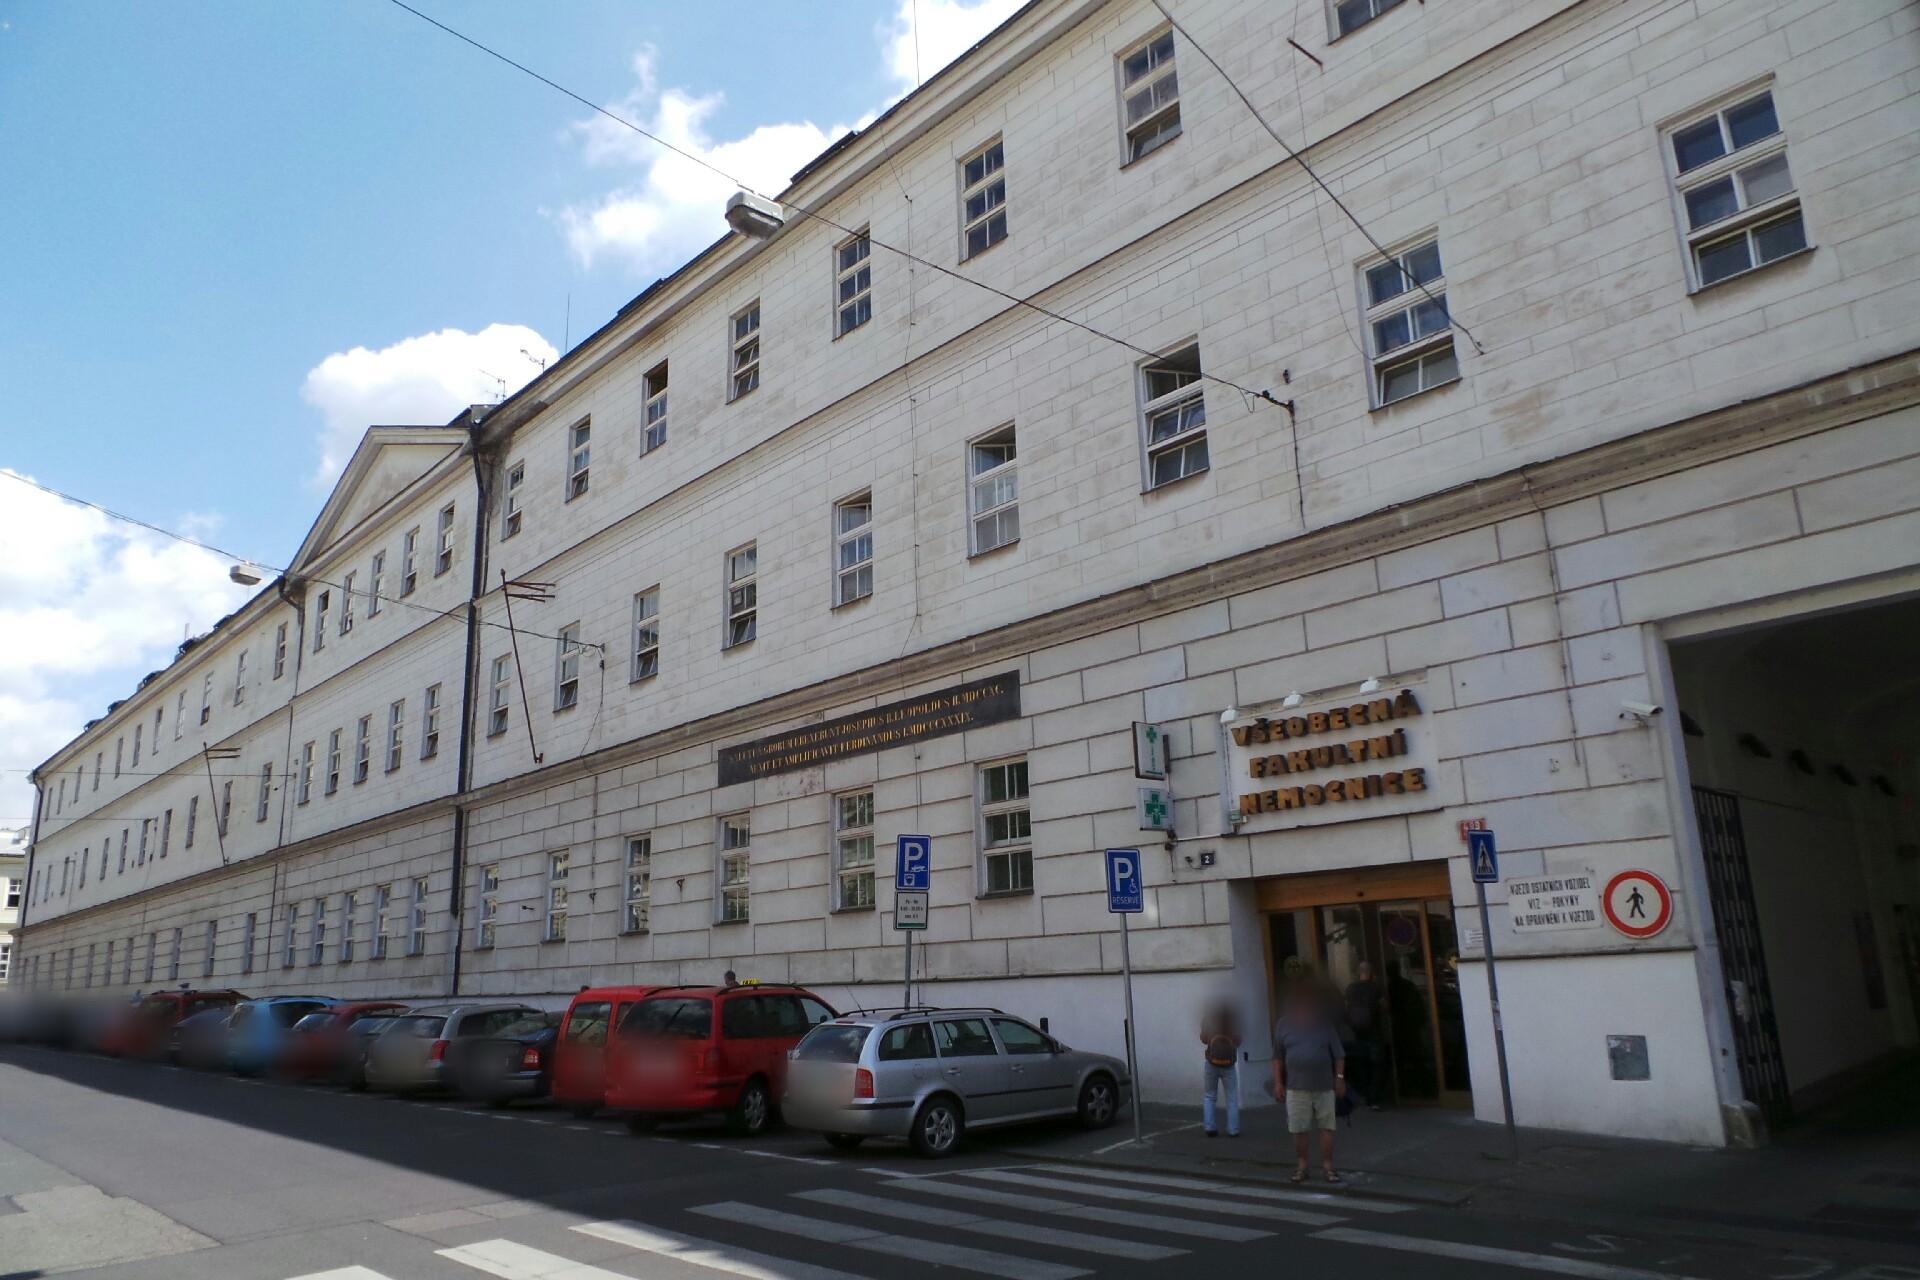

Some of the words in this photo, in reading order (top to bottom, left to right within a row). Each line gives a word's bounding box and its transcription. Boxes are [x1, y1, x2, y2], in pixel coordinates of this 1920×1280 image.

[842, 716, 885, 734] JOSEPHUS
[895, 699, 950, 720] LEOPOLDUS
[962, 685, 1004, 703] MDCCXC.
[1231, 689, 1423, 746] VŠEOBECNÁ
[772, 758, 782, 769] ET
[840, 730, 901, 752] FERDINANDUS
[1249, 728, 1408, 779] FAKULTNÍ
[1239, 767, 1427, 816] NEMOCNICE
[905, 842, 923, 872] P
[1113, 857, 1132, 892] P
[1204, 855, 1210, 864] 2
[1510, 883, 1530, 895] VJEZD
[1564, 877, 1590, 890] VOZIDEL
[1528, 898, 1541, 909] VIZ
[1552, 895, 1579, 907] POKYNY
[1515, 915, 1524, 926] NA
[1562, 912, 1567, 923] K
[1569, 909, 1595, 923] VJEZDU
